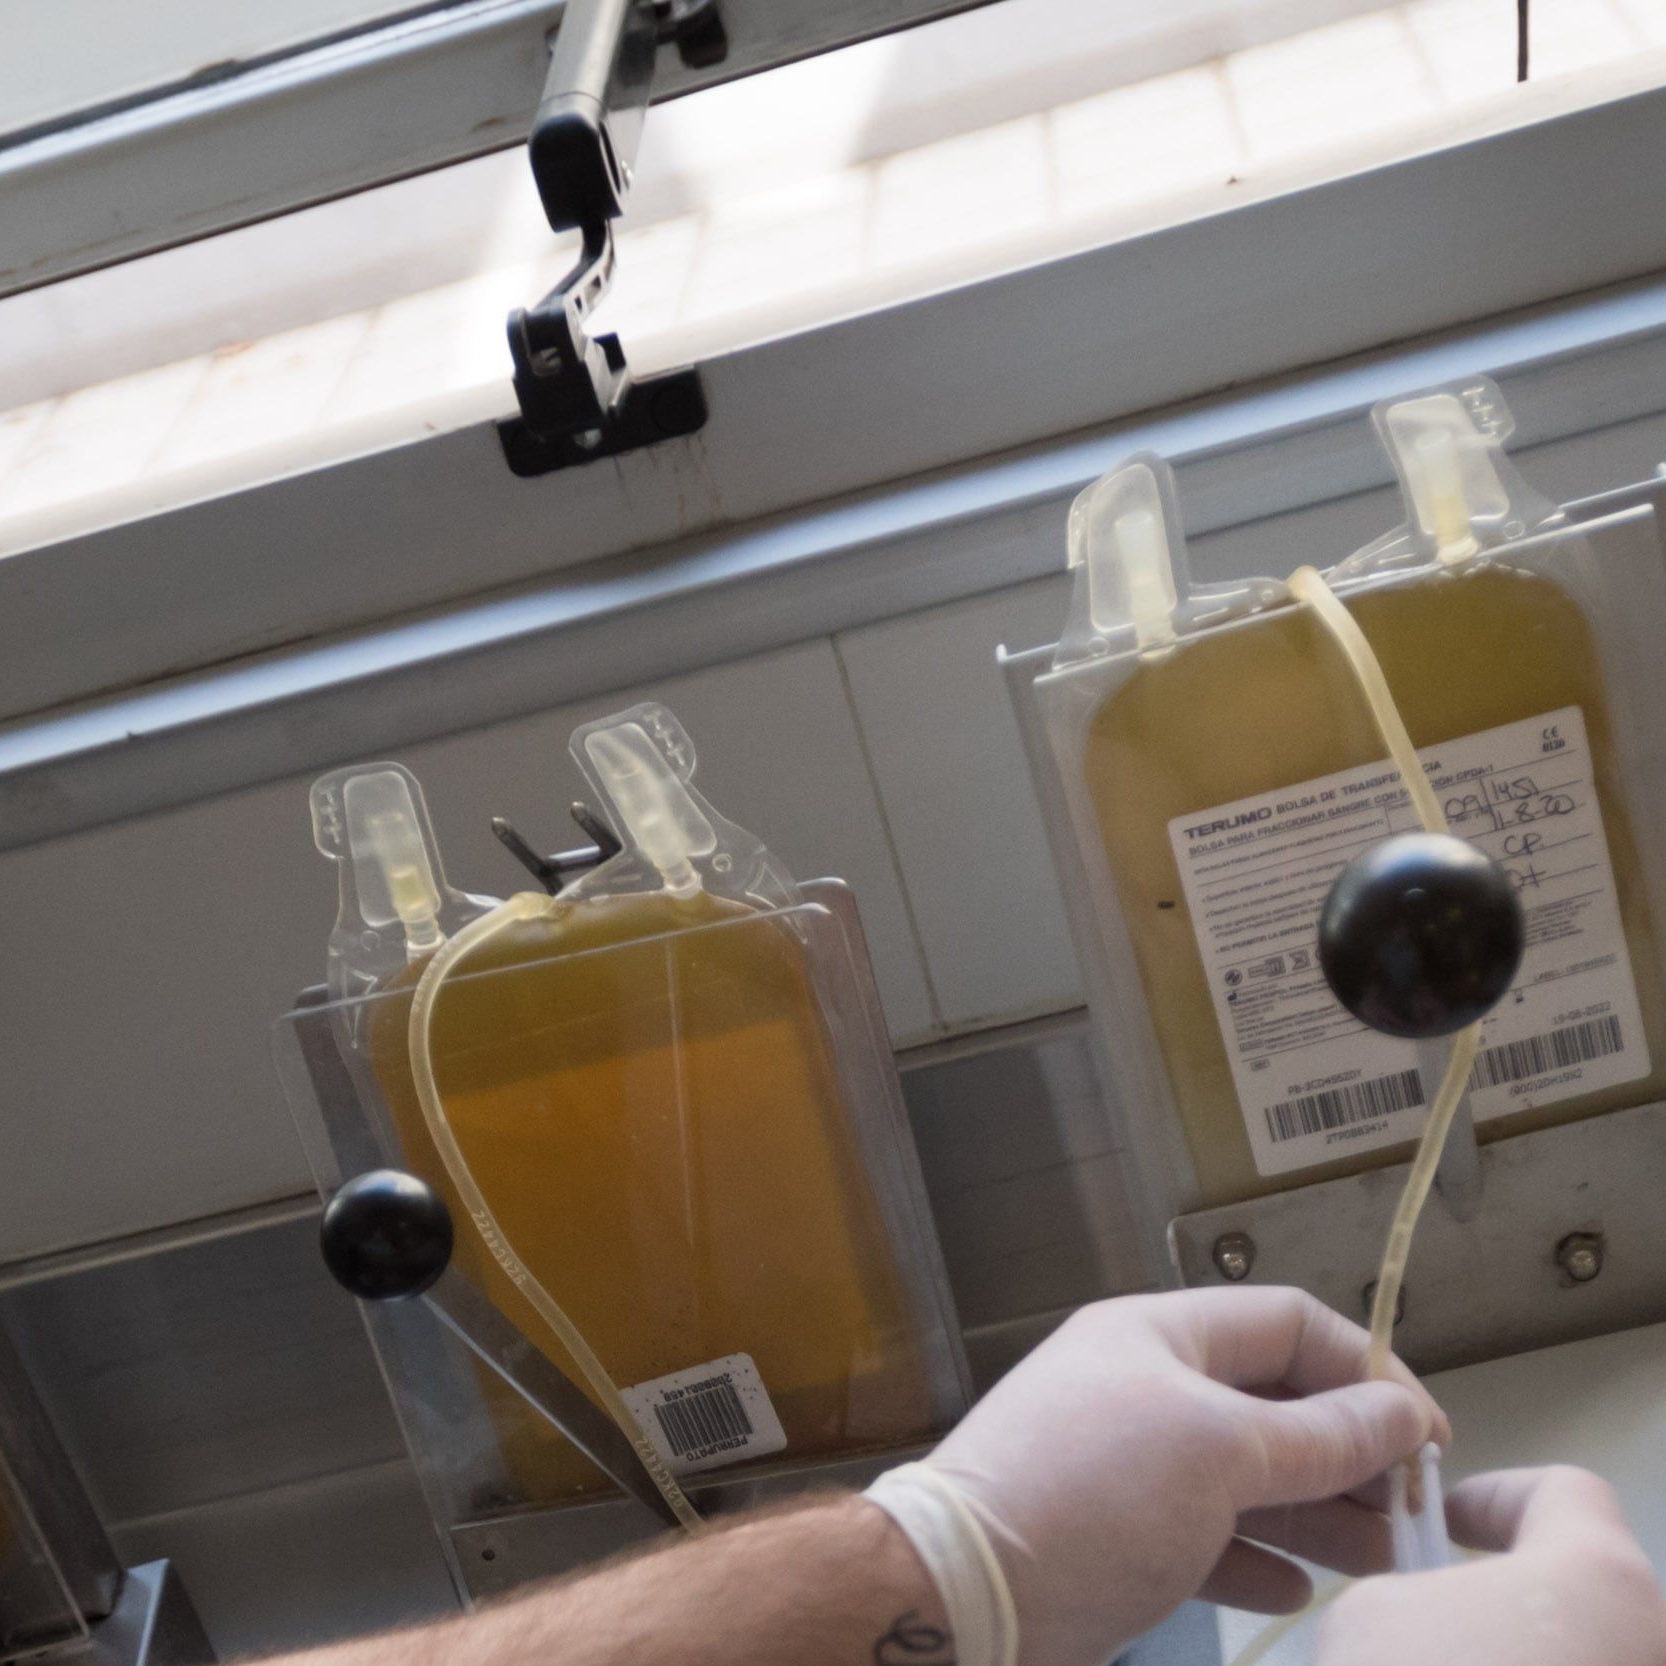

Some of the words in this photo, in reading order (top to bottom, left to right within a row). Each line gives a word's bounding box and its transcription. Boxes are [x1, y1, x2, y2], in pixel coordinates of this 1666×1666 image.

[1183, 806, 1273, 840] TERUMO
[1276, 795, 1318, 815] BOLSA
[1320, 789, 1337, 802] DE
[1341, 760, 1442, 796] TRANSFECIA
[1188, 838, 1225, 856] BOLSA
[1227, 829, 1254, 846] PARA
[1257, 811, 1326, 840] FRACCIONAR
[1328, 800, 1371, 819] SANGRE
[1374, 791, 1398, 805] CON
